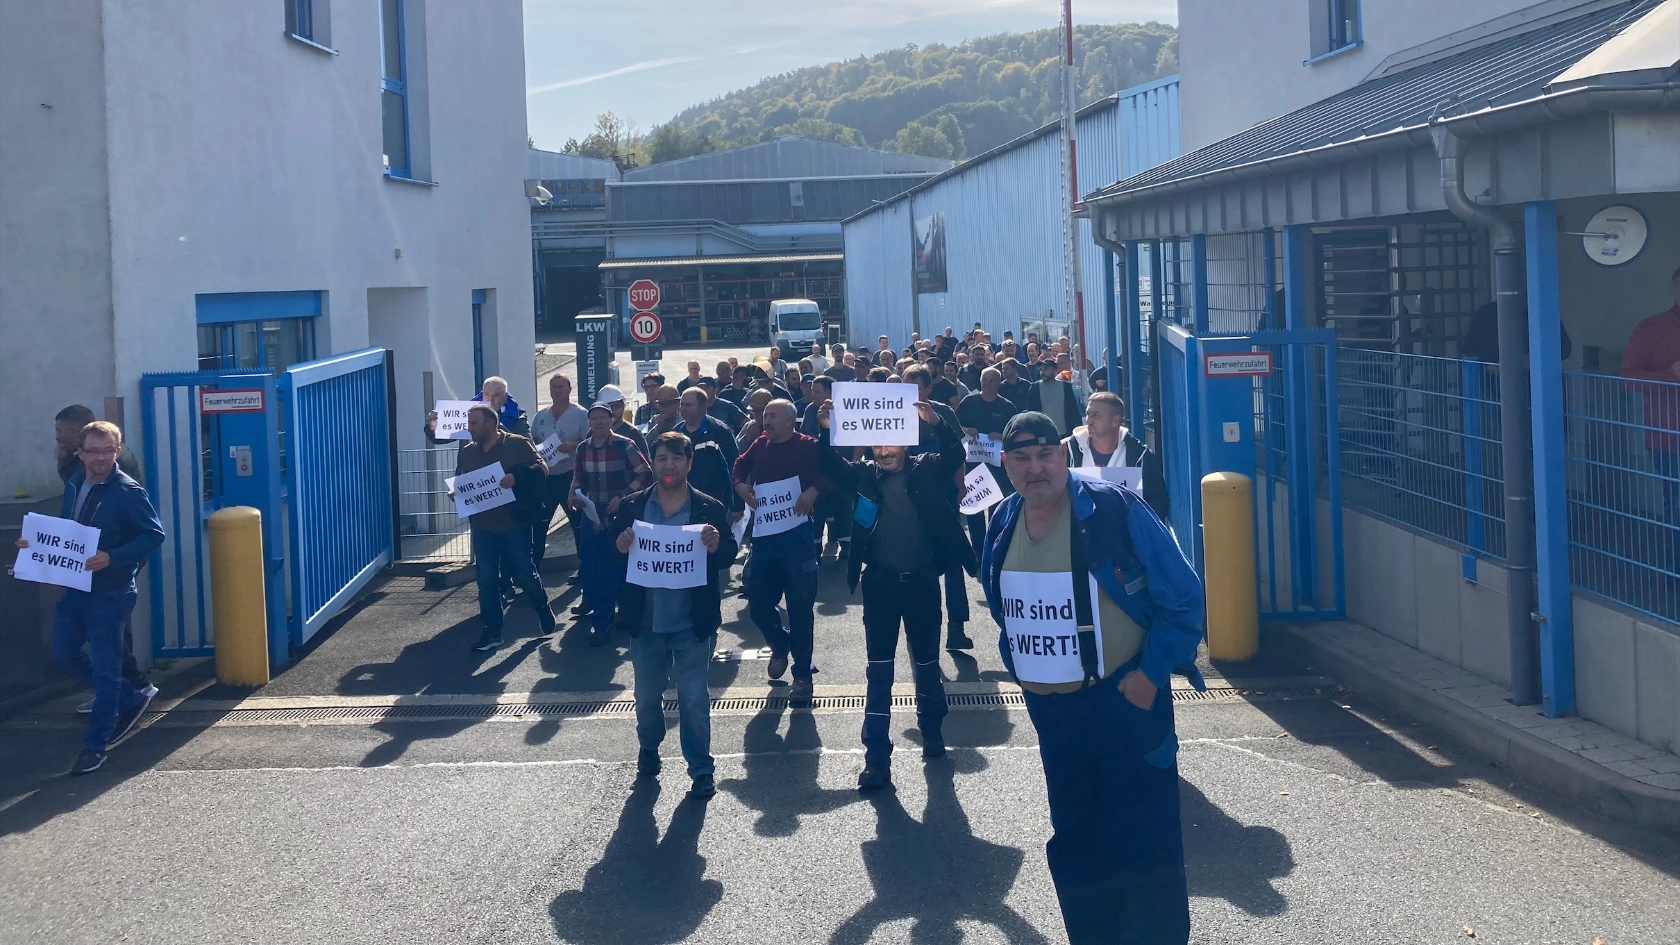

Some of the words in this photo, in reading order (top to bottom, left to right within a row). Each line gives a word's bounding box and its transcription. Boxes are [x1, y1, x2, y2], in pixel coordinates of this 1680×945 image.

[631, 289, 657, 302] STOP
[576, 322, 605, 332] LKW
[638, 320, 653, 334] 10
[587, 334, 596, 399] ANMELDUNG
[1209, 359, 1267, 369] Feuerwehrzufahrt
[204, 396, 260, 406] Feuerwehrzufahrt
[842, 397, 870, 410] WIR
[874, 397, 904, 410] sind
[443, 409, 460, 418] WIR
[841, 420, 858, 431] es
[861, 418, 905, 431] WERT!
[543, 449, 559, 463] ERT!
[457, 482, 474, 494] WIR
[476, 475, 497, 489] sind
[463, 498, 474, 506] es
[475, 487, 503, 503] WERT!
[769, 491, 792, 506] sind
[975, 487, 993, 502] WIR
[960, 498, 974, 507] sin
[763, 506, 796, 523] WERT!
[37, 531, 61, 547] WIR
[63, 539, 85, 555] sind
[638, 536, 661, 553] WIR
[664, 539, 694, 554] sind
[31, 552, 45, 563] es
[48, 553, 84, 573] WERT!
[636, 560, 648, 572] es
[652, 559, 694, 574] WERT!
[1001, 597, 1025, 619] WIR
[1030, 598, 1074, 621] sind
[1009, 637, 1015, 653] s
[1016, 633, 1079, 656] WERT!
